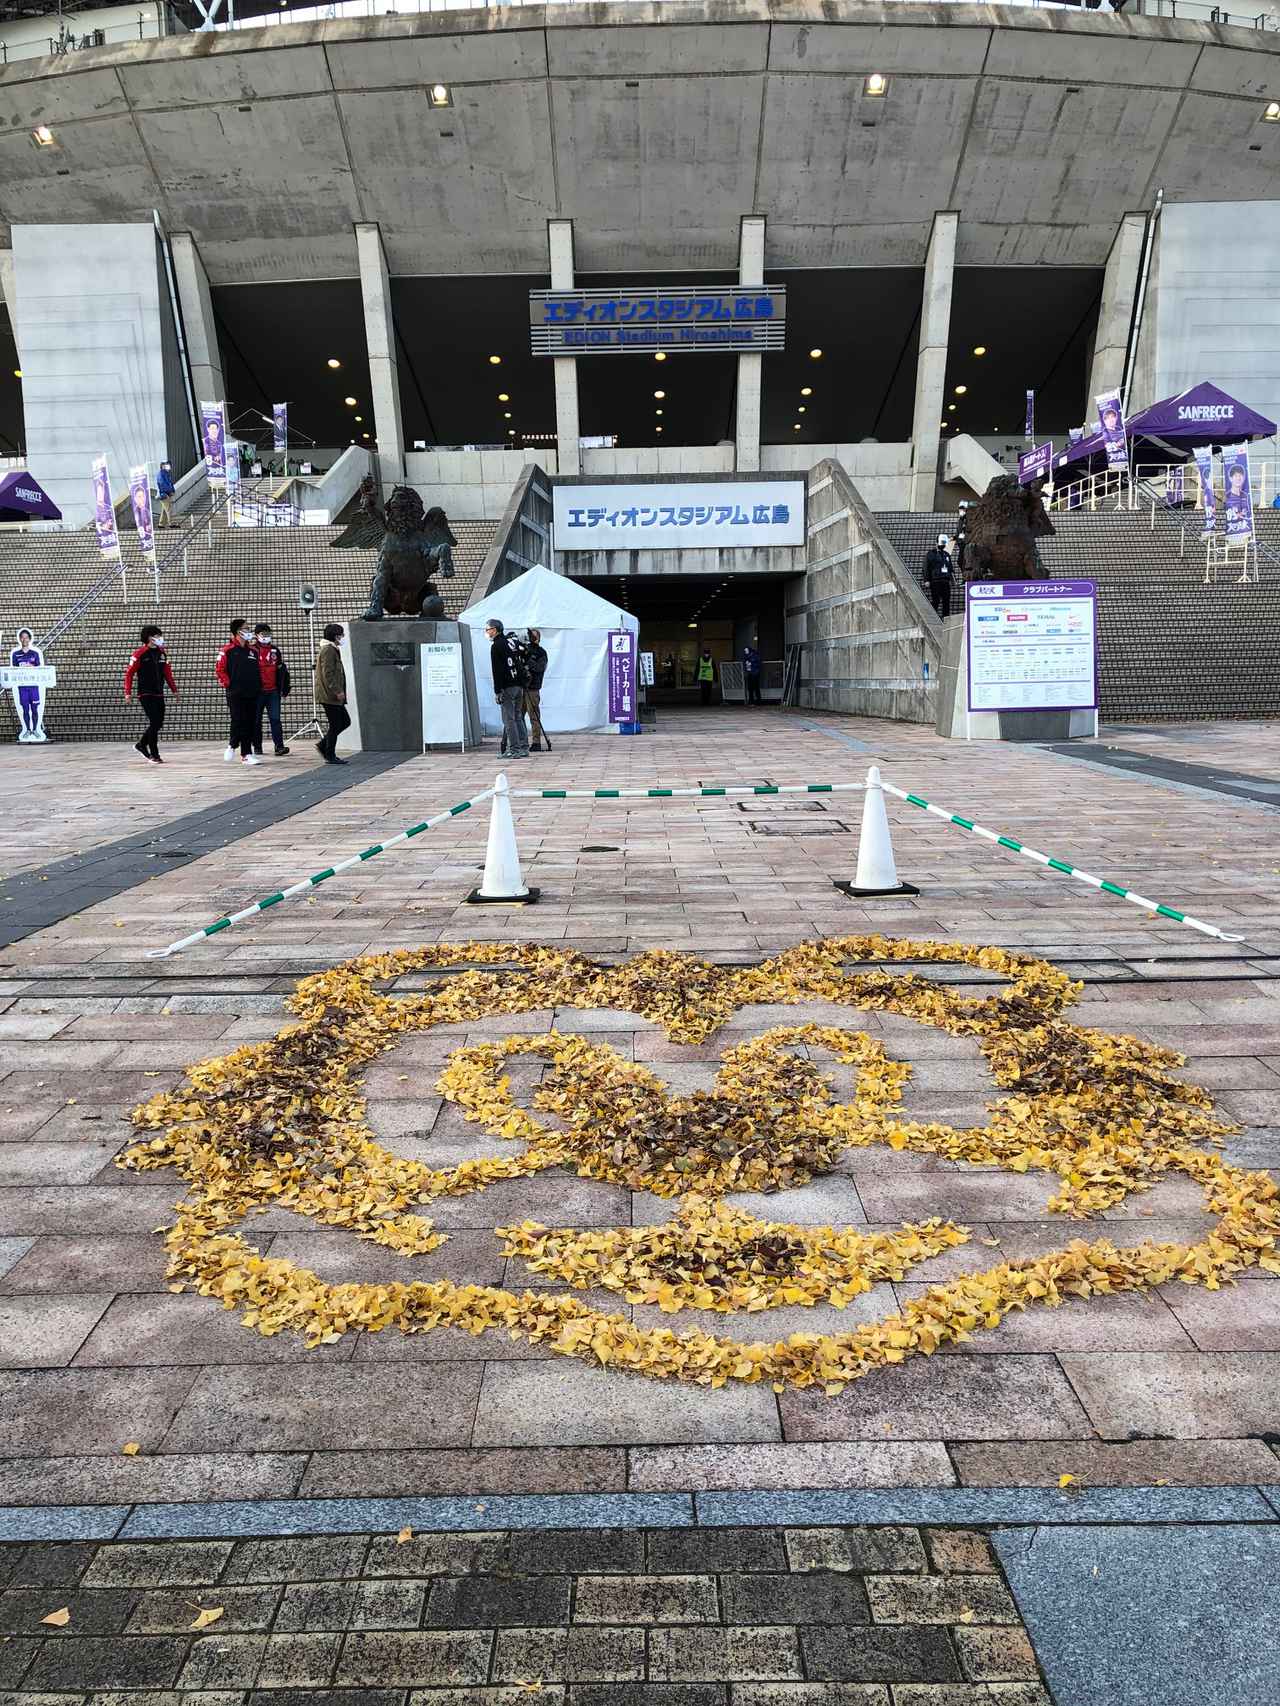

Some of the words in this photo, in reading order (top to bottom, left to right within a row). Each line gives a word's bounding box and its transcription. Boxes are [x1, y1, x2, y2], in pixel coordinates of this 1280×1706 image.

[543, 297, 774, 321] エディオンスタジアム広島
[563, 330, 611, 344] EDION
[617, 329, 674, 342] Stadium
[680, 327, 753, 341] Hiroshima
[1178, 405, 1234, 419] SANFRECCE
[568, 504, 790, 527] エディオンスタジアム広島
[1023, 586, 1073, 594] クラブパートナー
